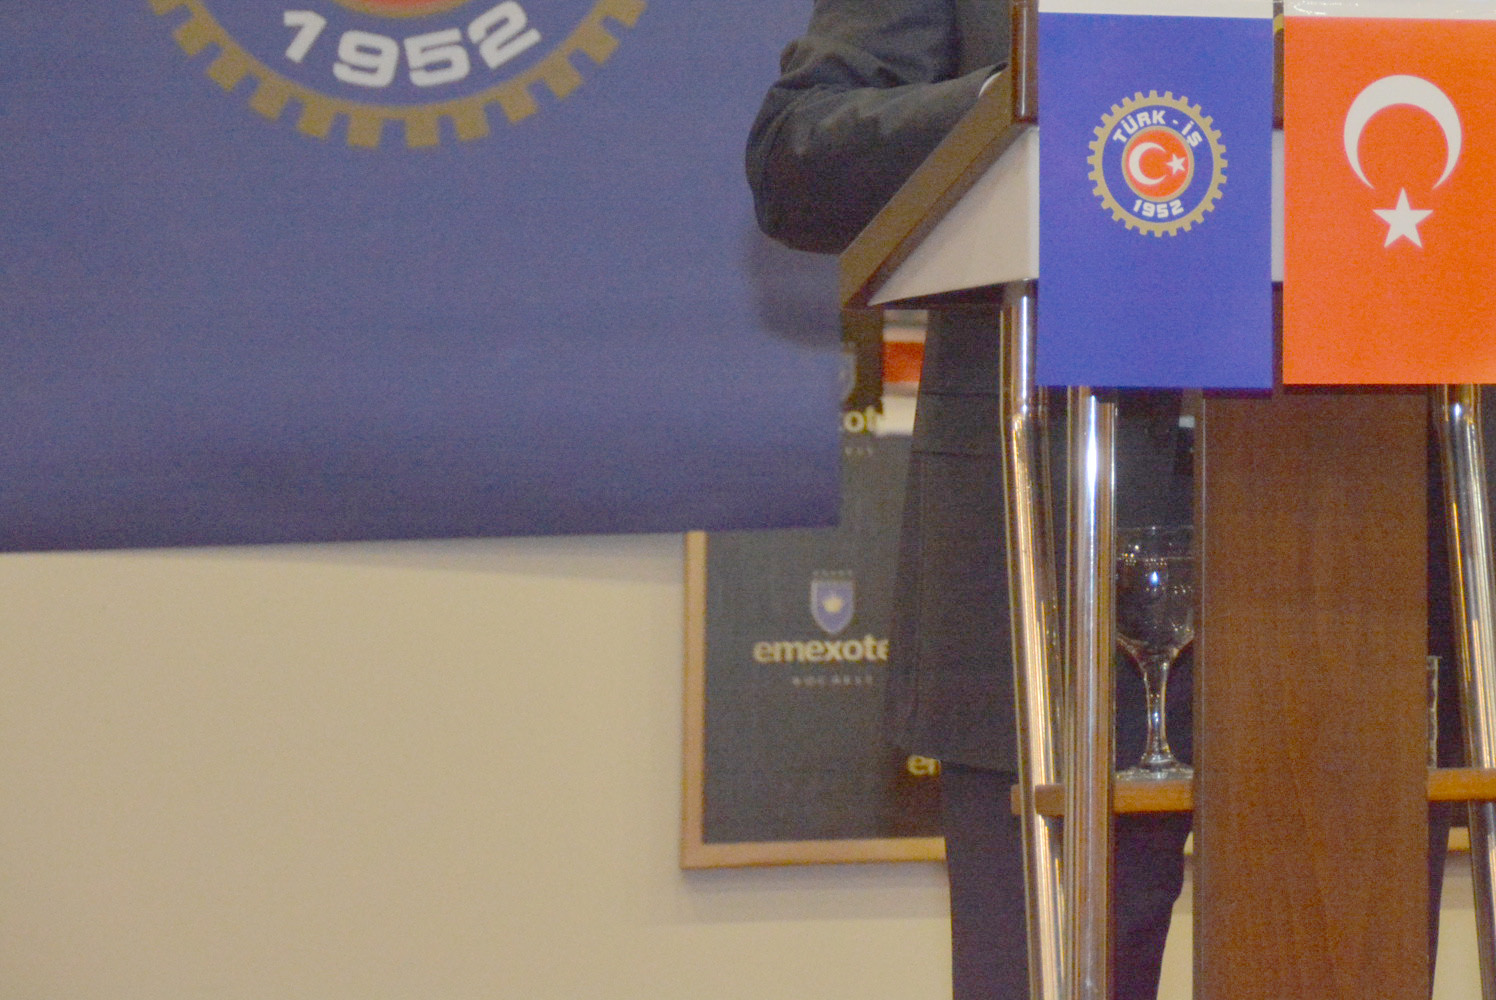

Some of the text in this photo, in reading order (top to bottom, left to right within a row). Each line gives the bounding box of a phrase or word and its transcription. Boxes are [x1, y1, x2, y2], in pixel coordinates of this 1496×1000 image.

[282, 0, 542, 88] 1952
[1133, 199, 1184, 219] 1952
[753, 633, 889, 664] emexote
